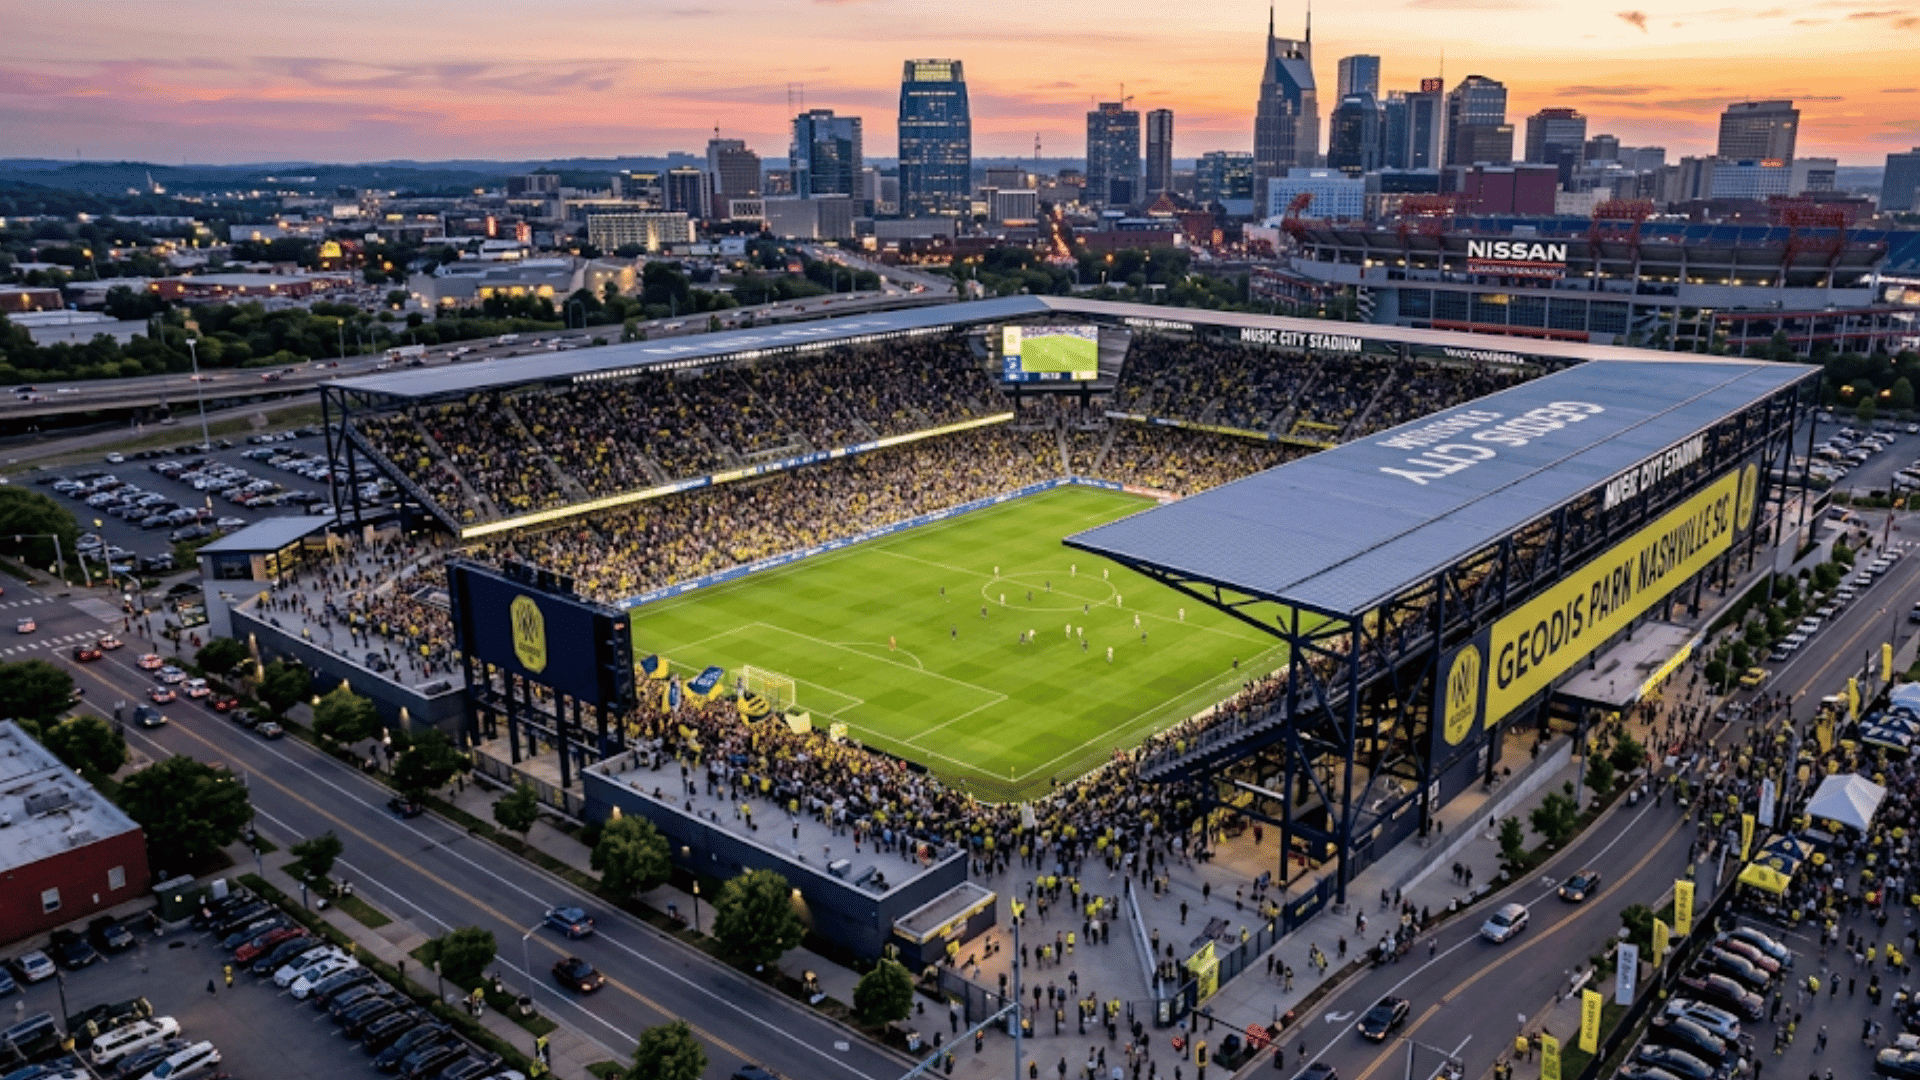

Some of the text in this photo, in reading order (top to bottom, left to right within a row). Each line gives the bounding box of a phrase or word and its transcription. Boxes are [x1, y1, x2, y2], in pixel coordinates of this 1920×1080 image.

[1467, 240, 1567, 261] NISSAN
[1240, 328, 1362, 352] MUSIC CITY STADIUM
[1379, 444, 1497, 486] CITY
[1496, 594, 1584, 690] GEODIS
[1587, 555, 1635, 628] PARK
[1636, 504, 1711, 594] NASHVILLE
[1712, 491, 1731, 540] SC
